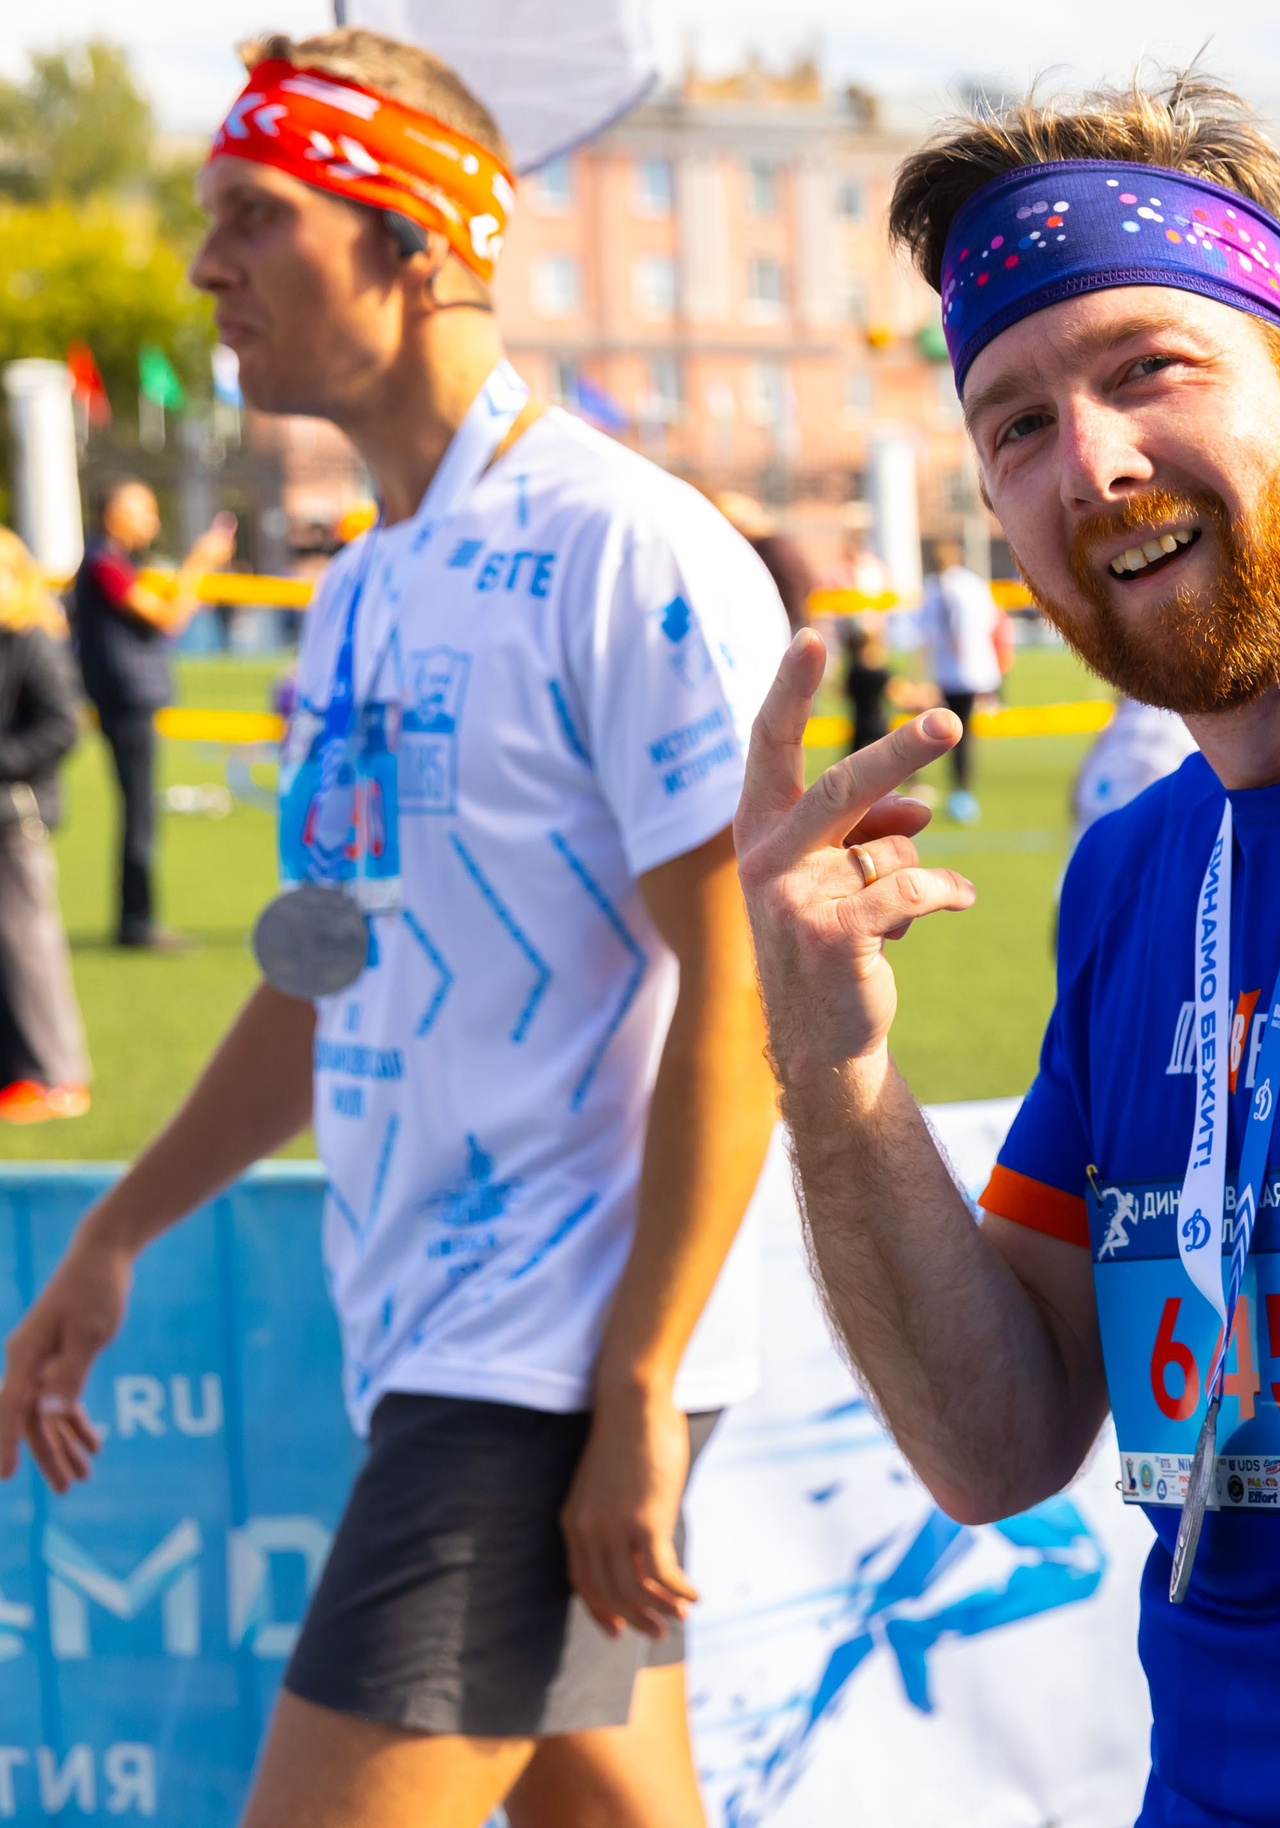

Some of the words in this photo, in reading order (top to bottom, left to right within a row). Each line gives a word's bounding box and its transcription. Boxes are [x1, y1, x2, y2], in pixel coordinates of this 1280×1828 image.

[1193, 1010, 1216, 1170] БЕЖИТ!
[1238, 1459, 1260, 1471] UDS
[1248, 1491, 1278, 1503] Effort
